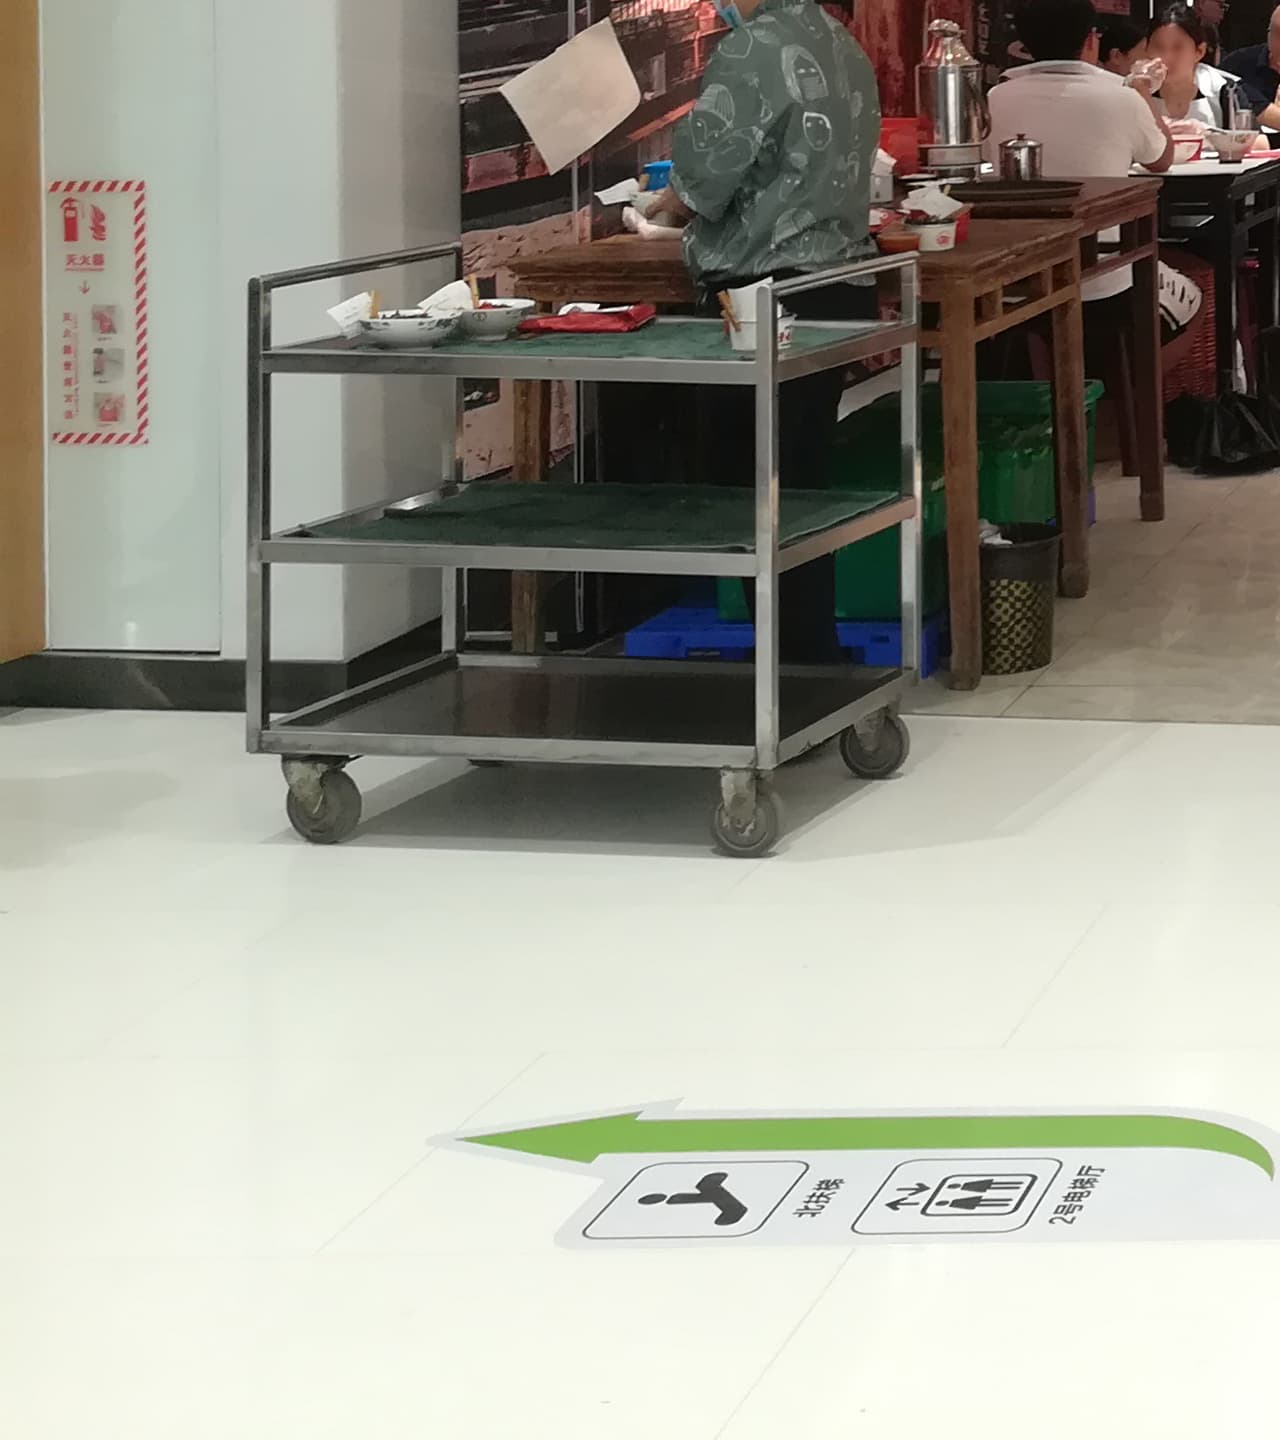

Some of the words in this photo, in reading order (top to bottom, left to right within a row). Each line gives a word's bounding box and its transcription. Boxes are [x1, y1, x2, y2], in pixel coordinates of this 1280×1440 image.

[65, 252, 105, 266] 灭火器
[792, 1176, 847, 1218] 北扶梯
[1048, 1164, 1107, 1226] 2号电梯厅
